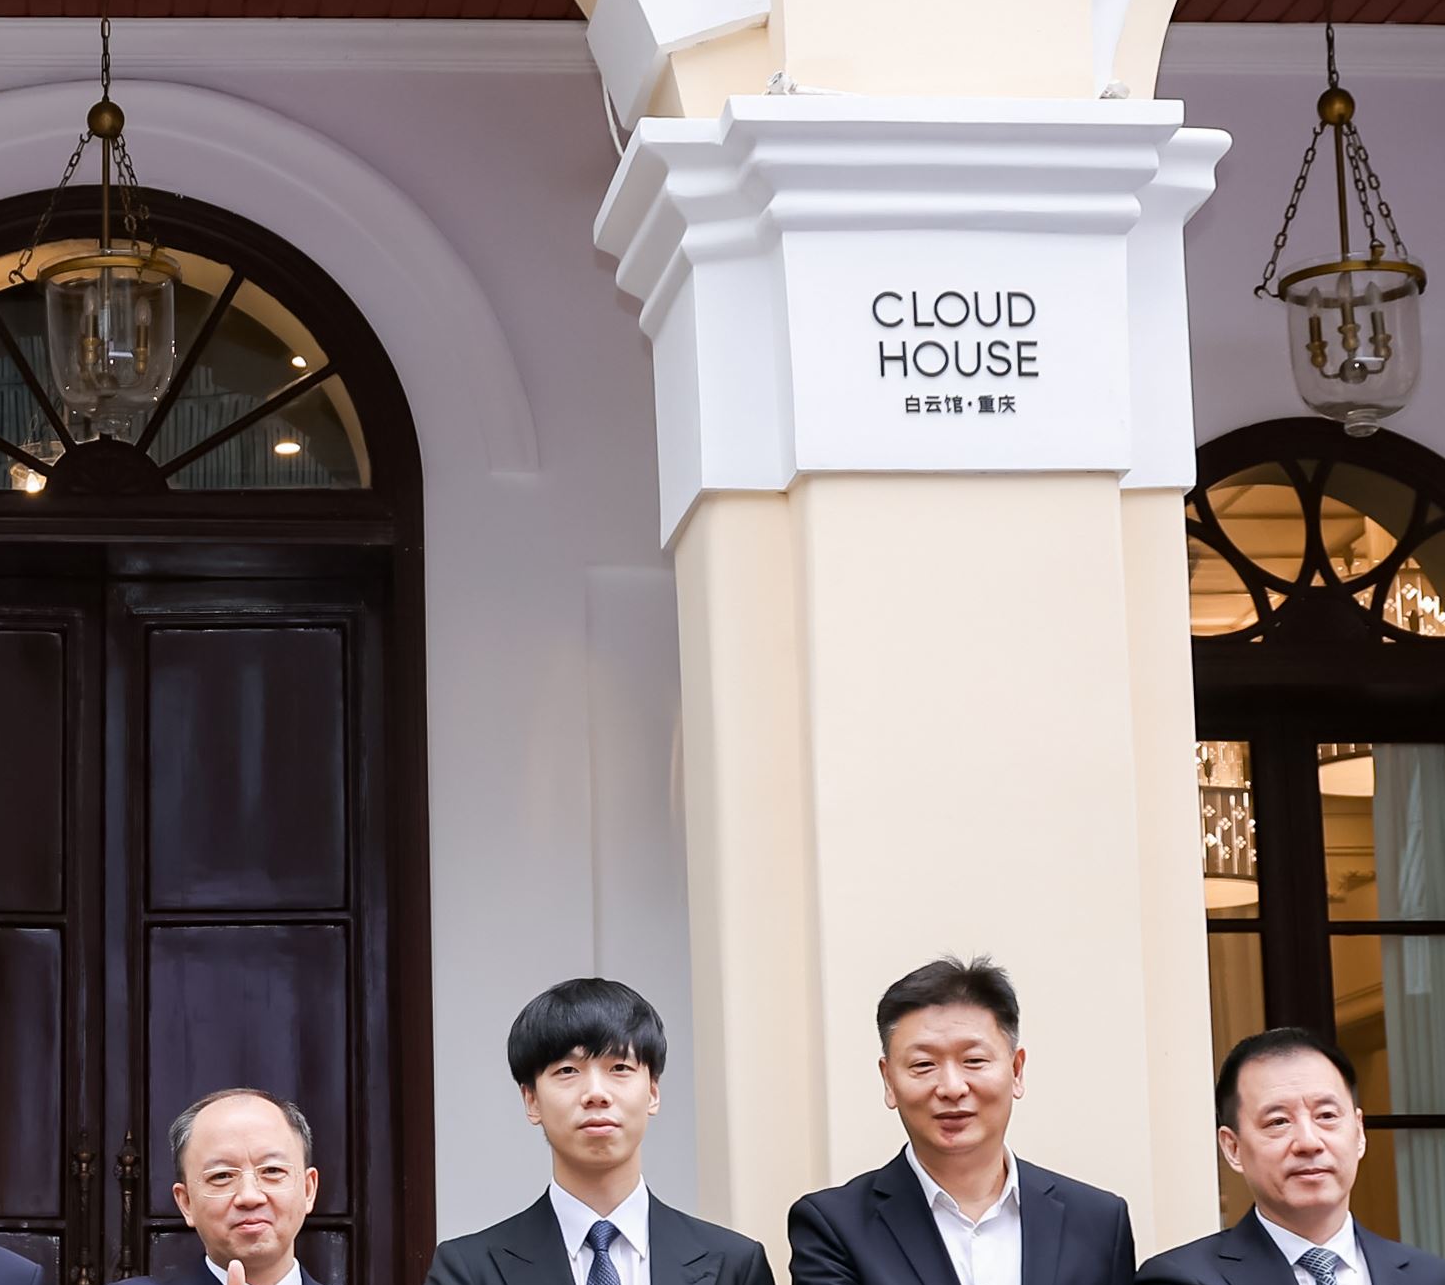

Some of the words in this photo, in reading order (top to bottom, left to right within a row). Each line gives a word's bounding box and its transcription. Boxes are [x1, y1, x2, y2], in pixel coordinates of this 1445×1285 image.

[872, 290, 1036, 328] CLOUD
[879, 340, 1039, 377] HOUSE
[905, 394, 1017, 414] 白云馆·重庆
